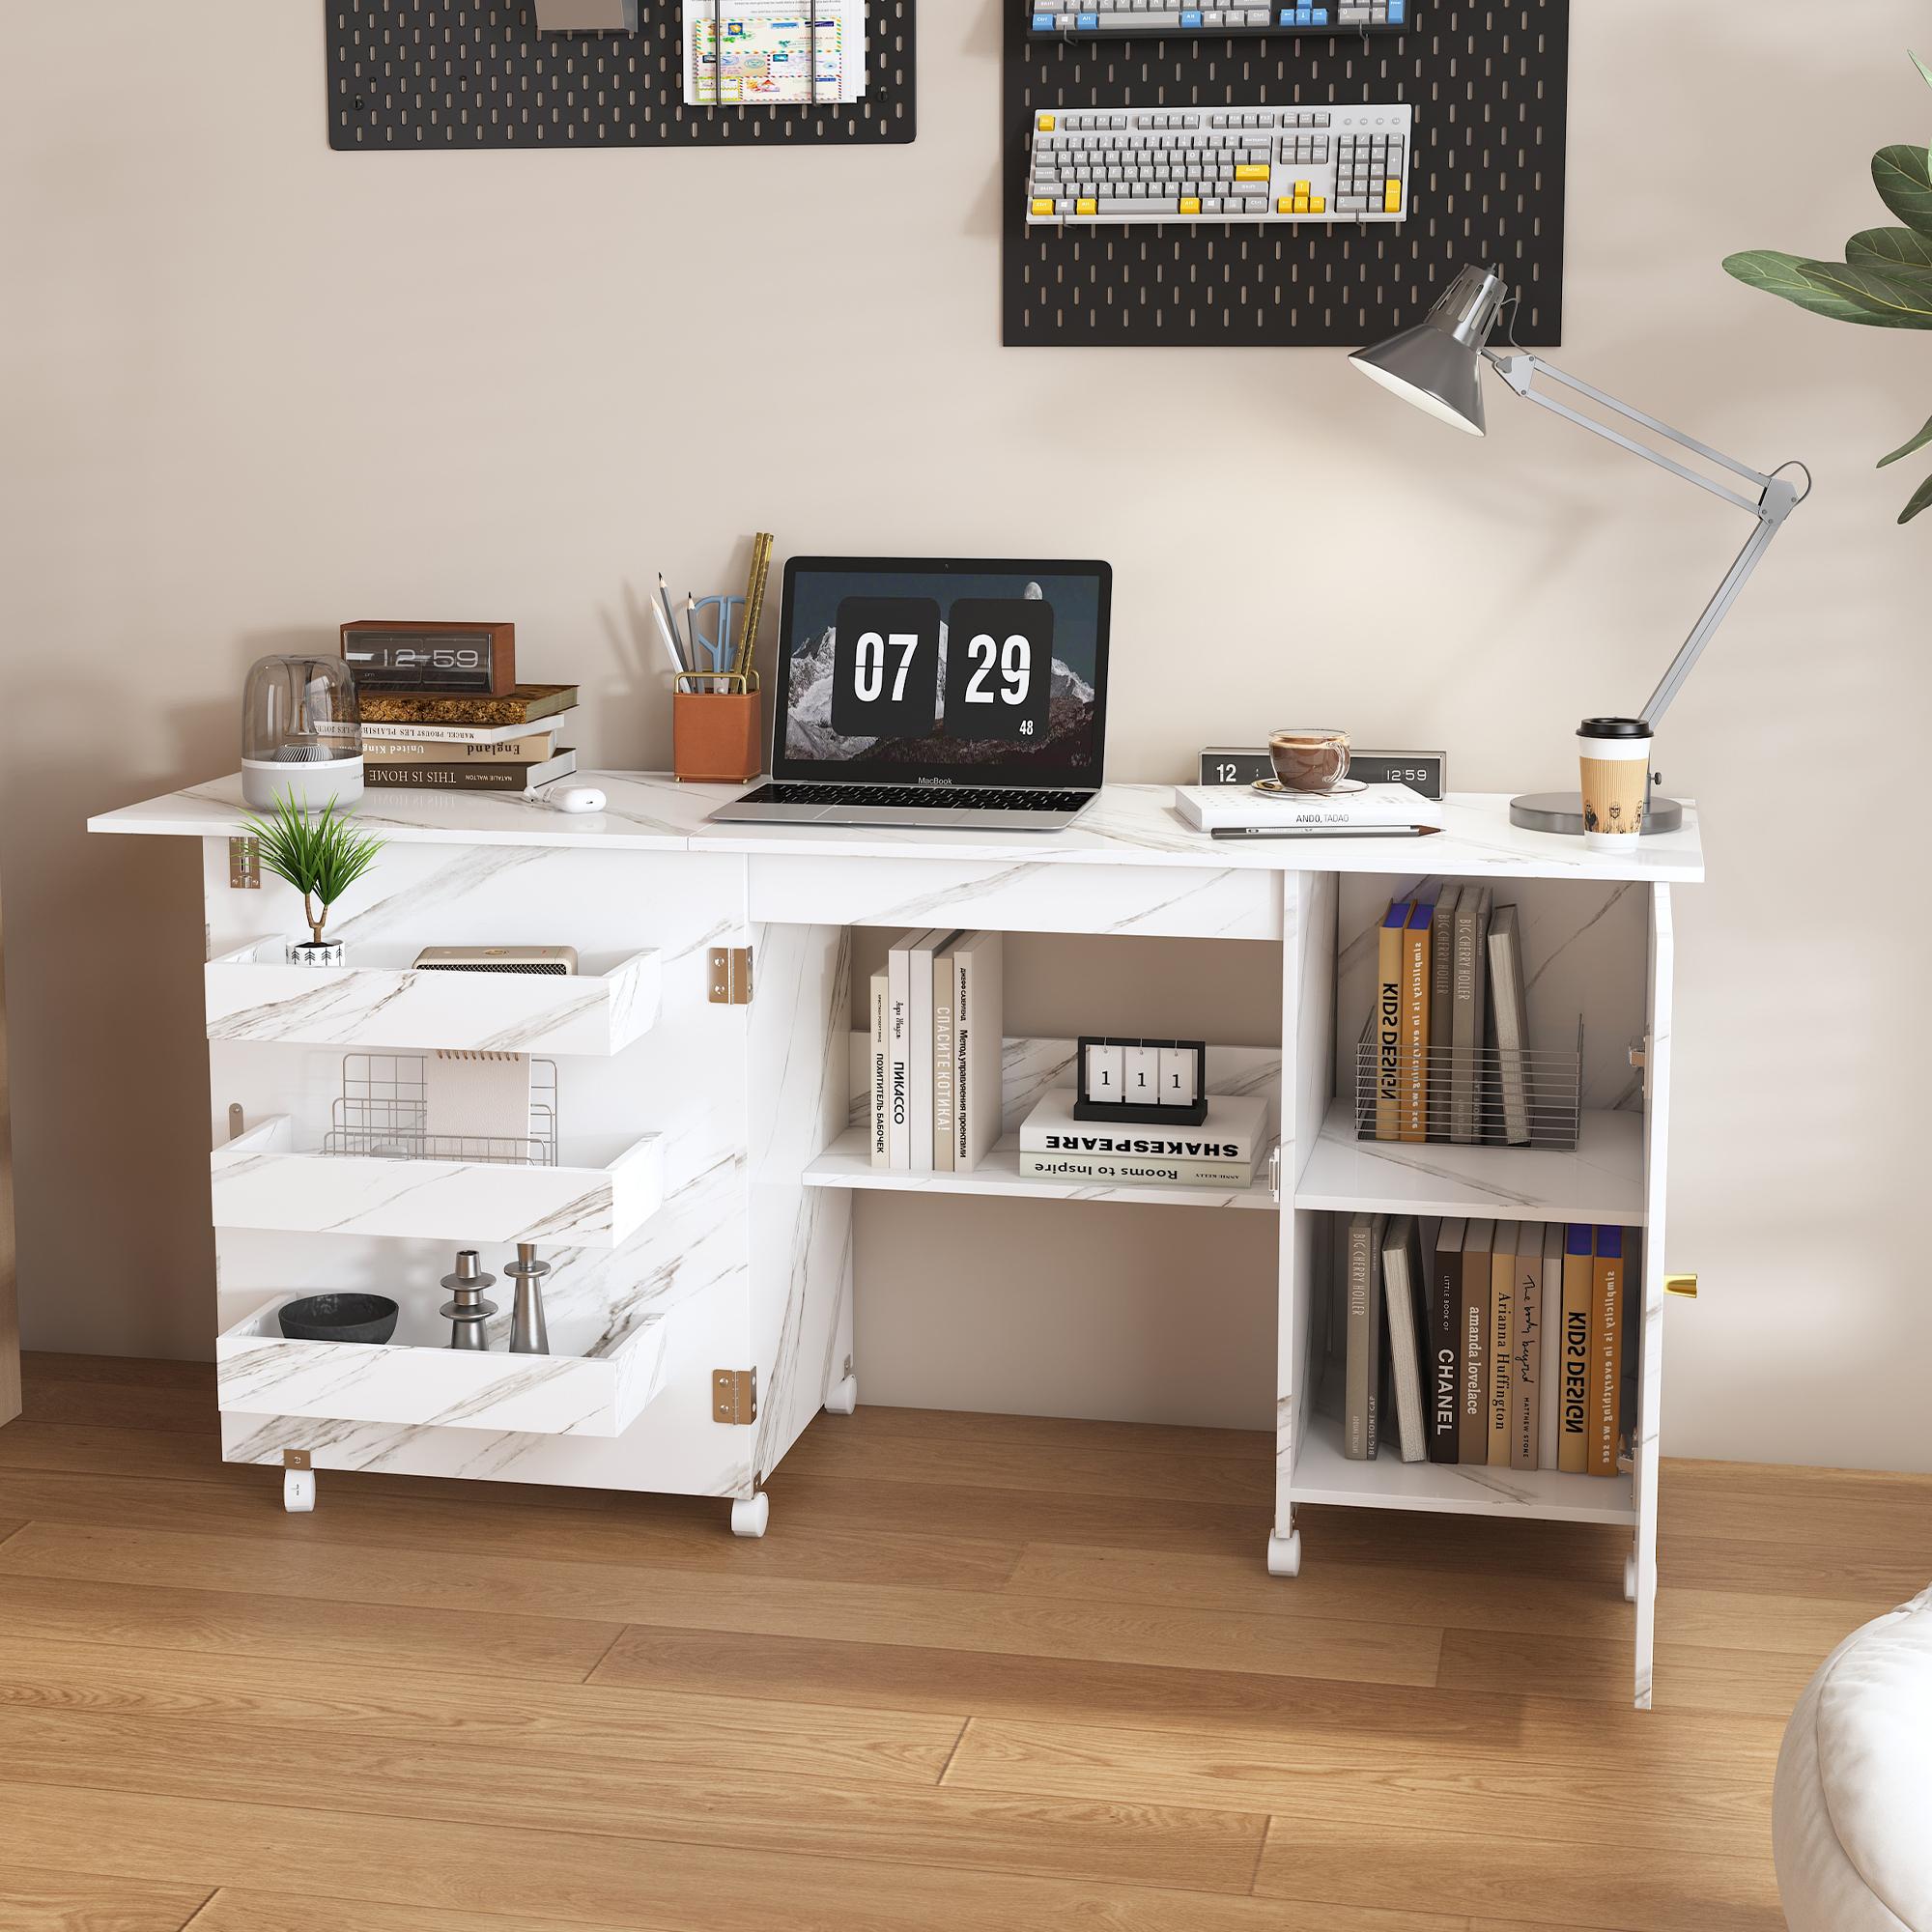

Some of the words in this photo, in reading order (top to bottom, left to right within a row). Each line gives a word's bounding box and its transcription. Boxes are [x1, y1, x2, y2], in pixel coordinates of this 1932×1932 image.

[854, 632, 919, 702] 07
[965, 634, 1031, 706] 29
[1019, 720, 1034, 735] 48
[390, 744, 425, 754] United
[467, 743, 520, 756] England
[369, 769, 408, 782] HOME
[412, 771, 423, 782] IS
[427, 771, 456, 783] THIS
[1216, 764, 1237, 782] 12
[1324, 814, 1349, 822] TADAO
[1459, 919, 1472, 933] BIG
[1459, 936, 1472, 968] CHERRY
[1458, 970, 1471, 1000] HOLLER
[937, 1007, 950, 1067] СПАСИТЕ
[958, 1029, 967, 1057] Метод
[1102, 1071, 1111, 1085] 1
[1137, 1073, 1146, 1087] 1
[1172, 1074, 1181, 1088] 1
[894, 1062, 905, 1124] ПИКАССО
[938, 1072, 950, 1130] КОТИКА!
[1046, 1135, 1239, 1157] SHAKESPEARE
[1035, 1163, 1092, 1176] Inspire
[1098, 1166, 1115, 1176] to
[1122, 1167, 1178, 1179] Rooms
[1353, 1234, 1366, 1247] BIG
[1352, 1251, 1365, 1281] CHERRY
[1352, 1285, 1365, 1315] HOLLER
[1443, 1322, 1449, 1331] OF
[1498, 1292, 1511, 1347] Arianna
[1468, 1307, 1481, 1357] amanda
[1437, 1349, 1454, 1435] CHANEL
[1467, 1362, 1481, 1415] lovelace
[1492, 1354, 1509, 1429] Huffington
